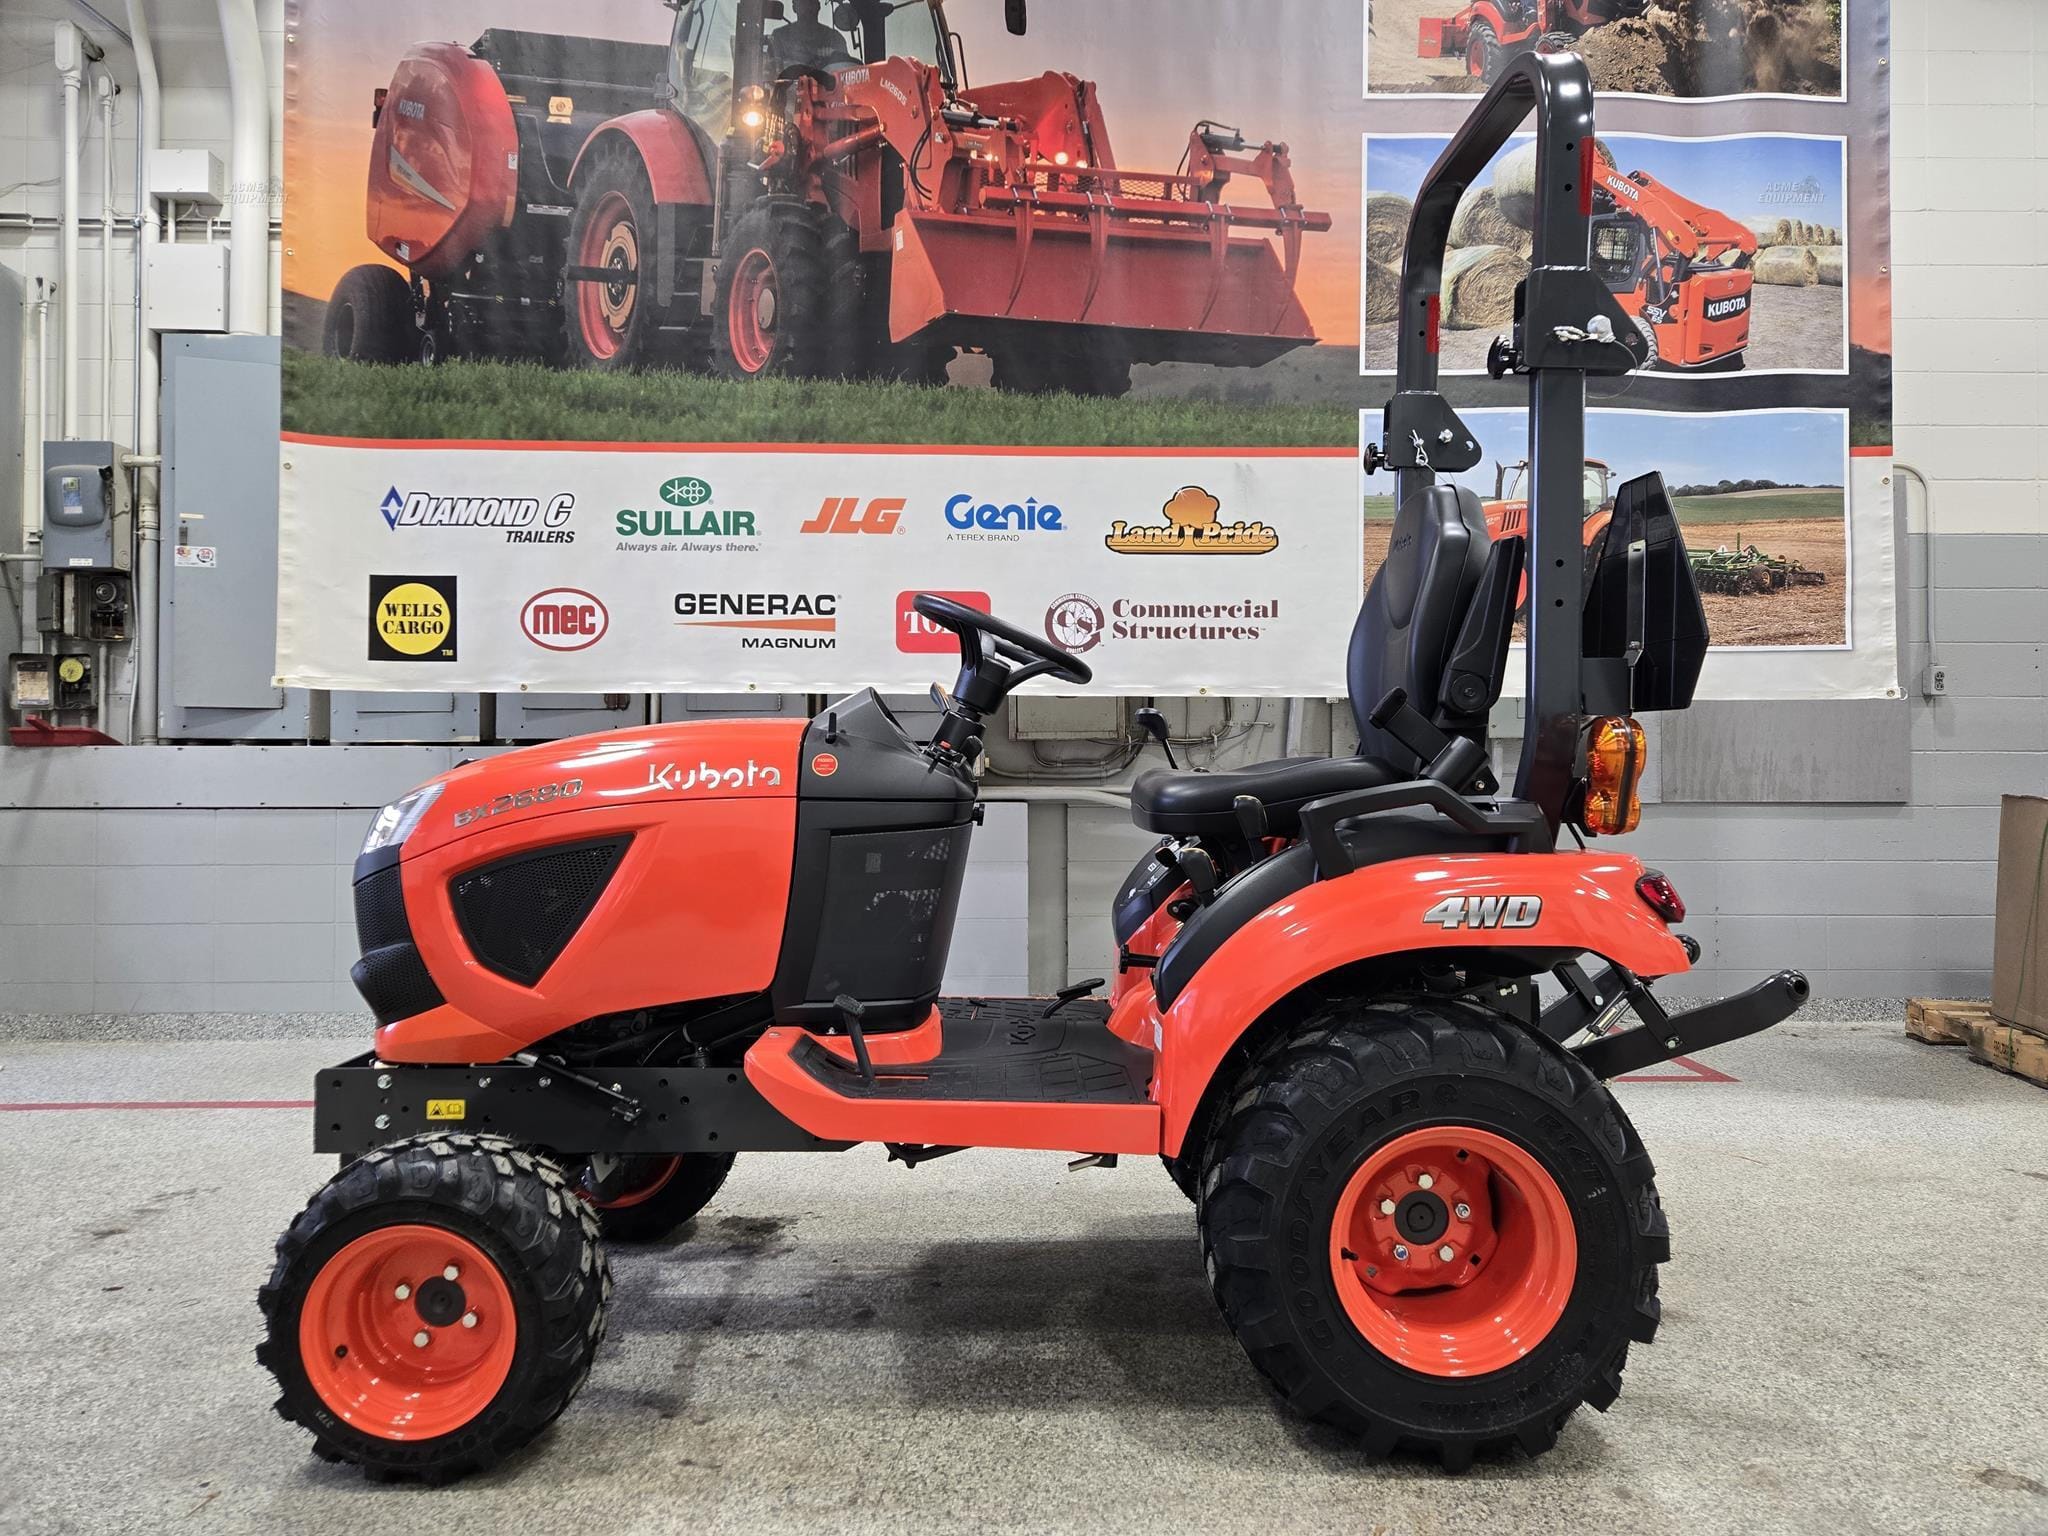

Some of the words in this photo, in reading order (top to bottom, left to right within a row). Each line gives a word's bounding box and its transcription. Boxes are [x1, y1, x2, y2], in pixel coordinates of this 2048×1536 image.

[840, 68, 870, 85] KUBOTA
[1606, 175, 1639, 201] KUBOTA
[1646, 306, 1667, 318] SSV
[1707, 297, 1746, 317] KUBOTA
[1651, 315, 1663, 324] 65
[398, 492, 540, 527] DIAMOND
[544, 493, 575, 528] C
[800, 497, 907, 535] JLG
[945, 494, 1062, 530] Genie
[616, 509, 755, 537] SULLAIR
[1111, 521, 1181, 544] Land
[1200, 521, 1276, 545] Pride
[506, 530, 576, 544] TRAILERS
[987, 534, 1020, 542] BRAND
[616, 542, 657, 553] Always
[660, 542, 678, 552] air.
[681, 542, 723, 553] Always
[726, 542, 759, 552] there.
[384, 603, 442, 617] WELLS
[674, 593, 836, 616] GENERAC
[1112, 599, 1279, 618] Commercial
[382, 620, 444, 635] CARGO
[1112, 620, 1260, 640] Structures
[742, 638, 836, 648] MAGNUM
[648, 760, 781, 790] Kubota
[454, 779, 583, 827] BX2680
[1423, 895, 1543, 929] 4WD
[1289, 1088, 1422, 1350] GOODYEAR
